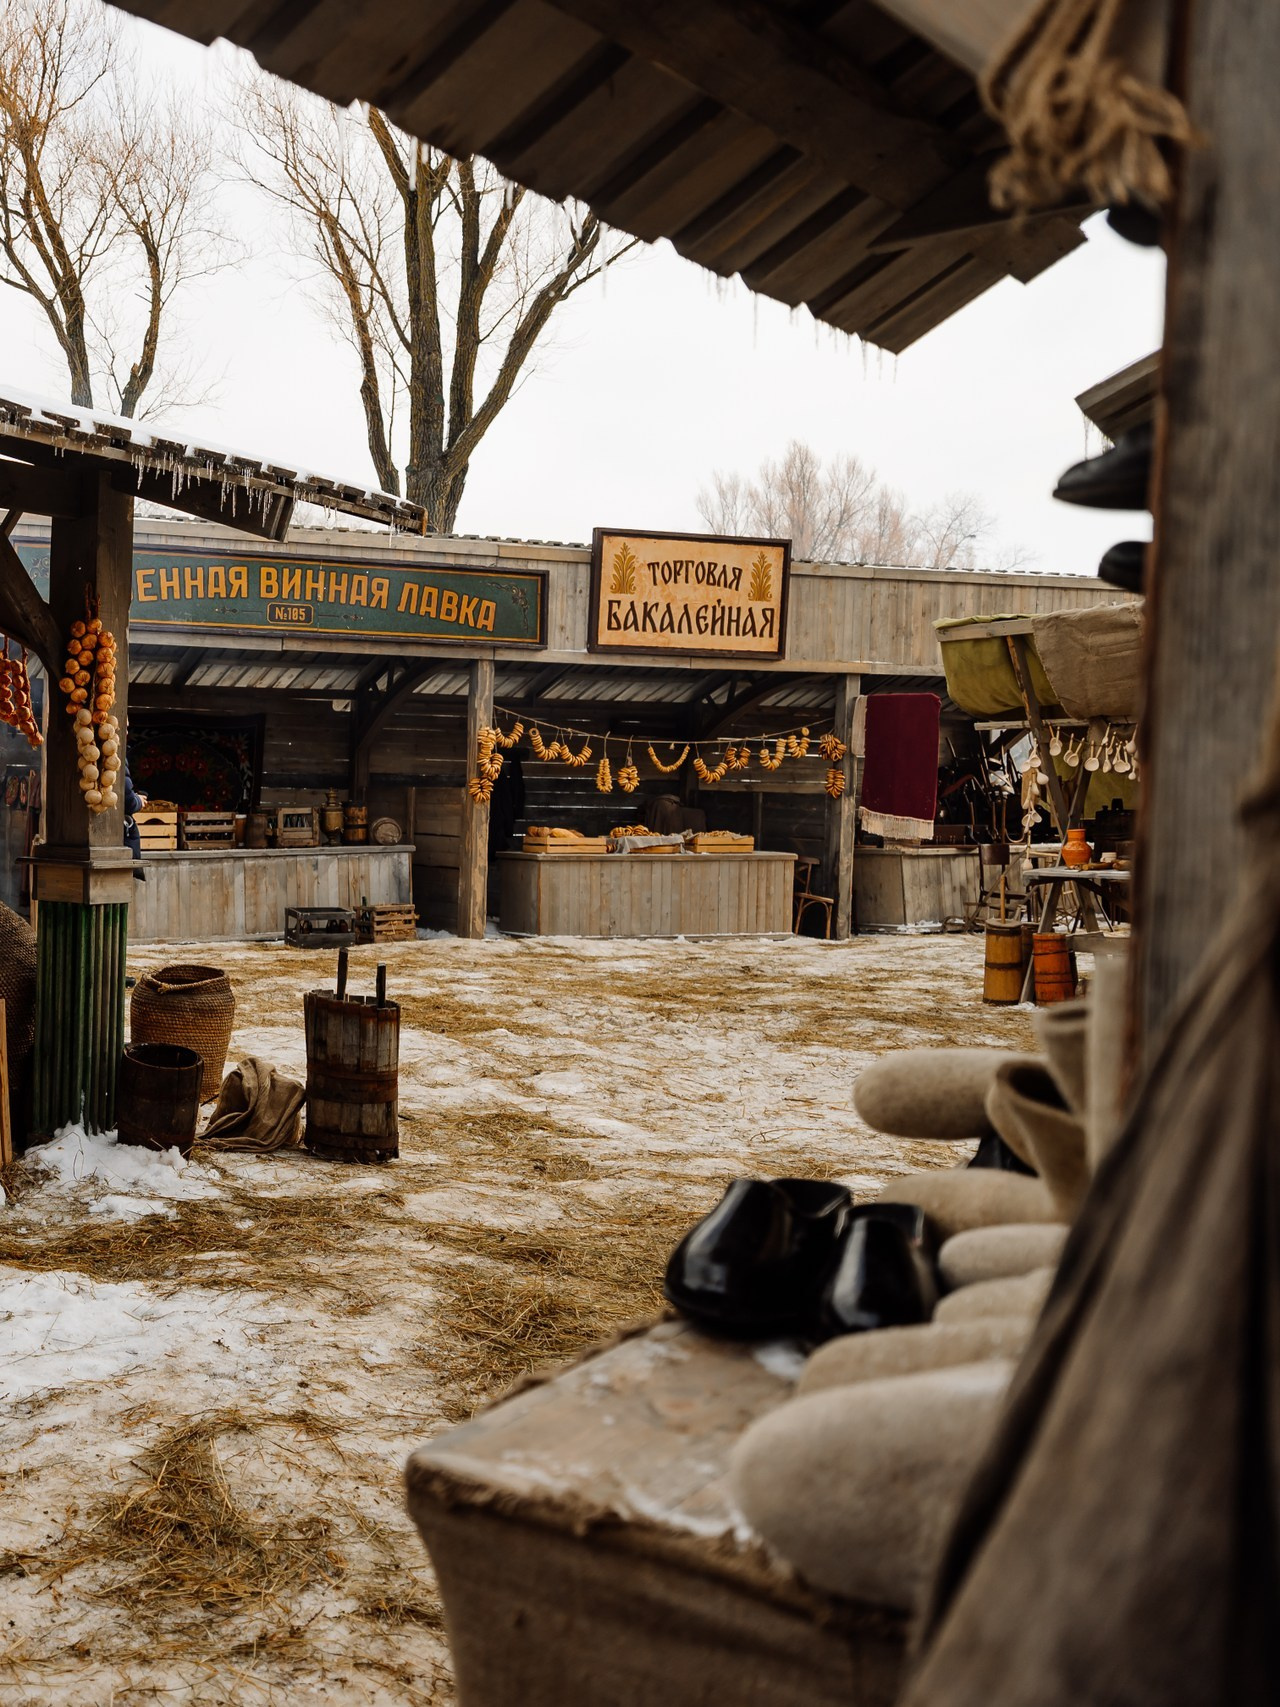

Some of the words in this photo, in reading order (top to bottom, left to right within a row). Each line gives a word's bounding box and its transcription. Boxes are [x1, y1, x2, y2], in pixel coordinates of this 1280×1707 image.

[647, 560, 743, 591] ТОРГОВЛЯ
[131, 566, 248, 602] ЕННАЯ
[260, 566, 390, 609] ВИННАЯ
[397, 582, 497, 632] ЛАВКА
[275, 606, 306, 621] №105
[607, 599, 775, 638] БАКАЛЕЙНАЯ
